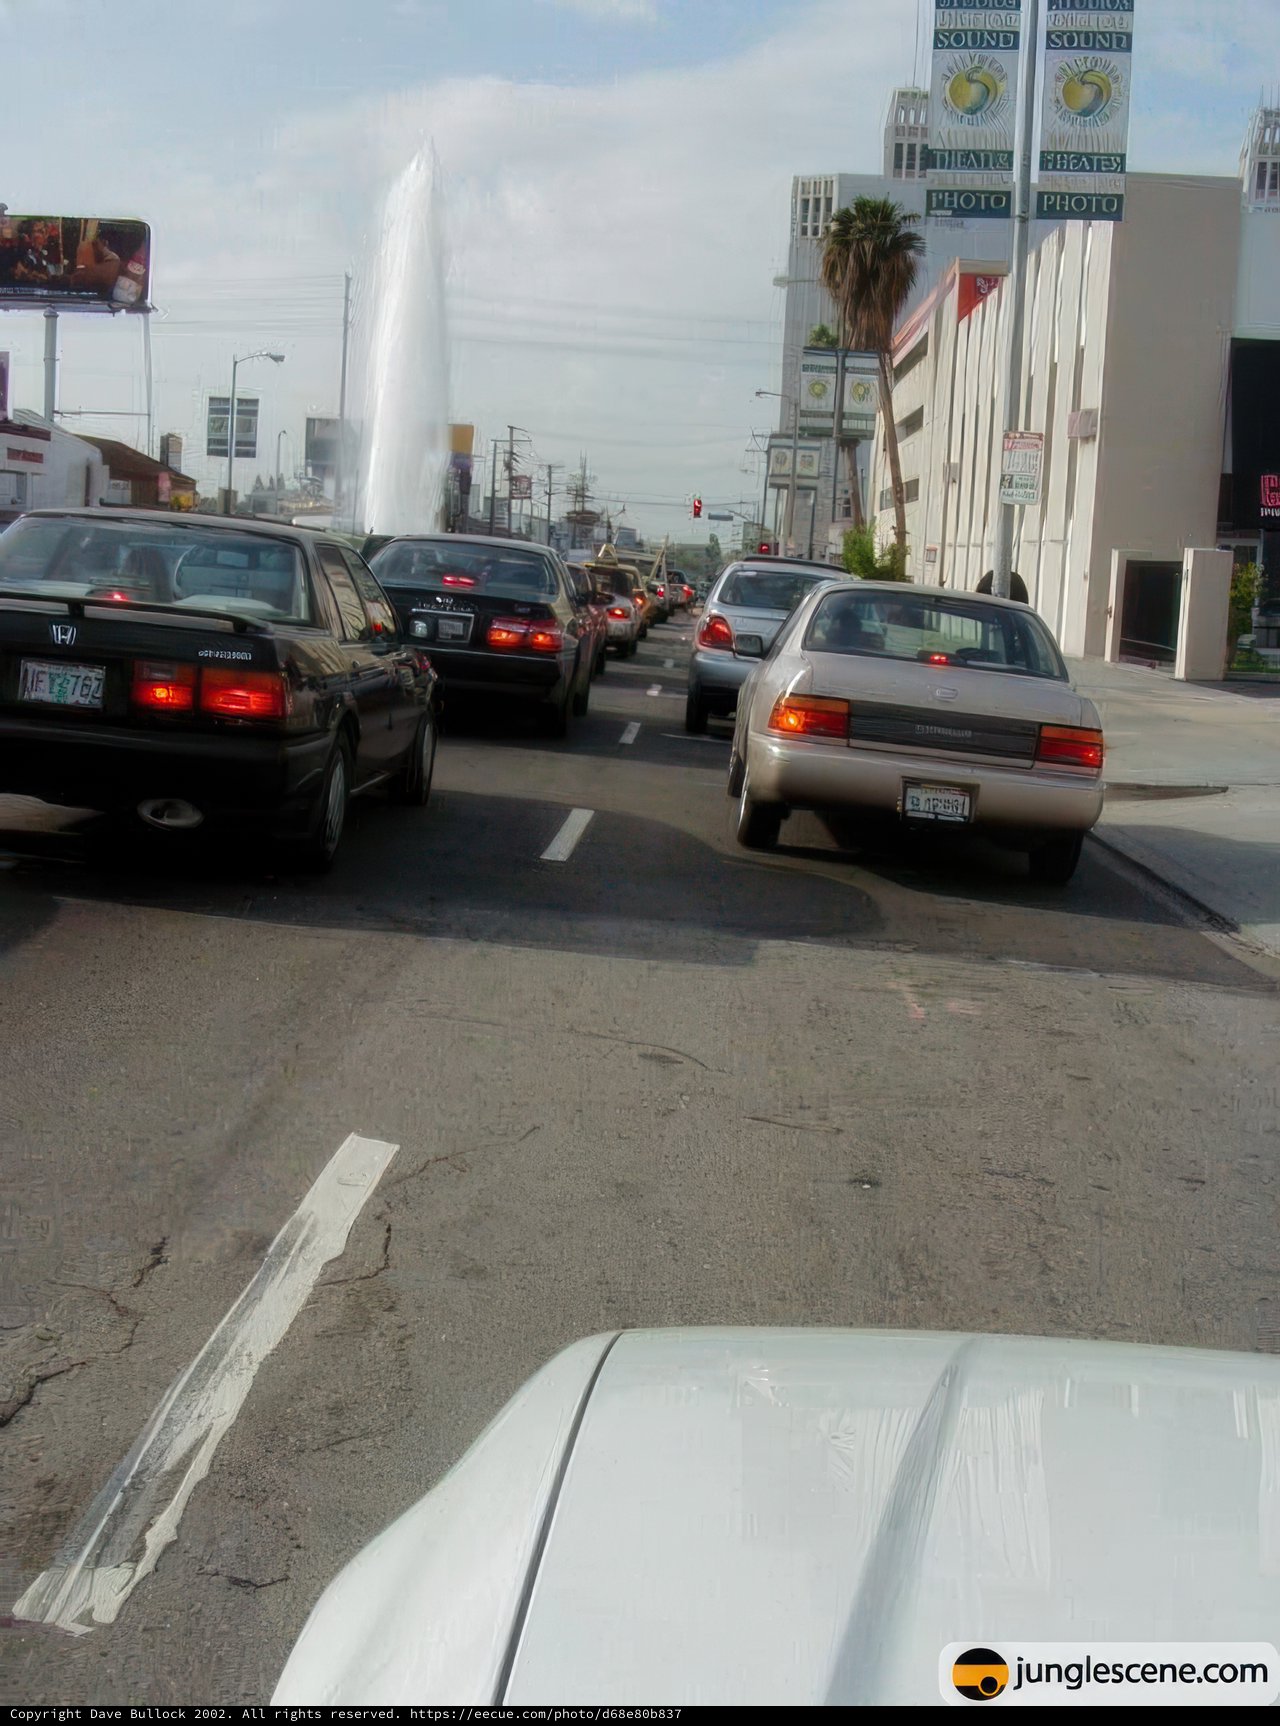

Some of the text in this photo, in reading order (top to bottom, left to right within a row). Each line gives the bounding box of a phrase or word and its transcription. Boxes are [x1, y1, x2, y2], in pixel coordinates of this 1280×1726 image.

[937, 31, 1015, 48] SOUND
[1049, 32, 1127, 49] SOUND
[932, 192, 1007, 210] PHOTO
[1043, 194, 1118, 213] PHOTO
